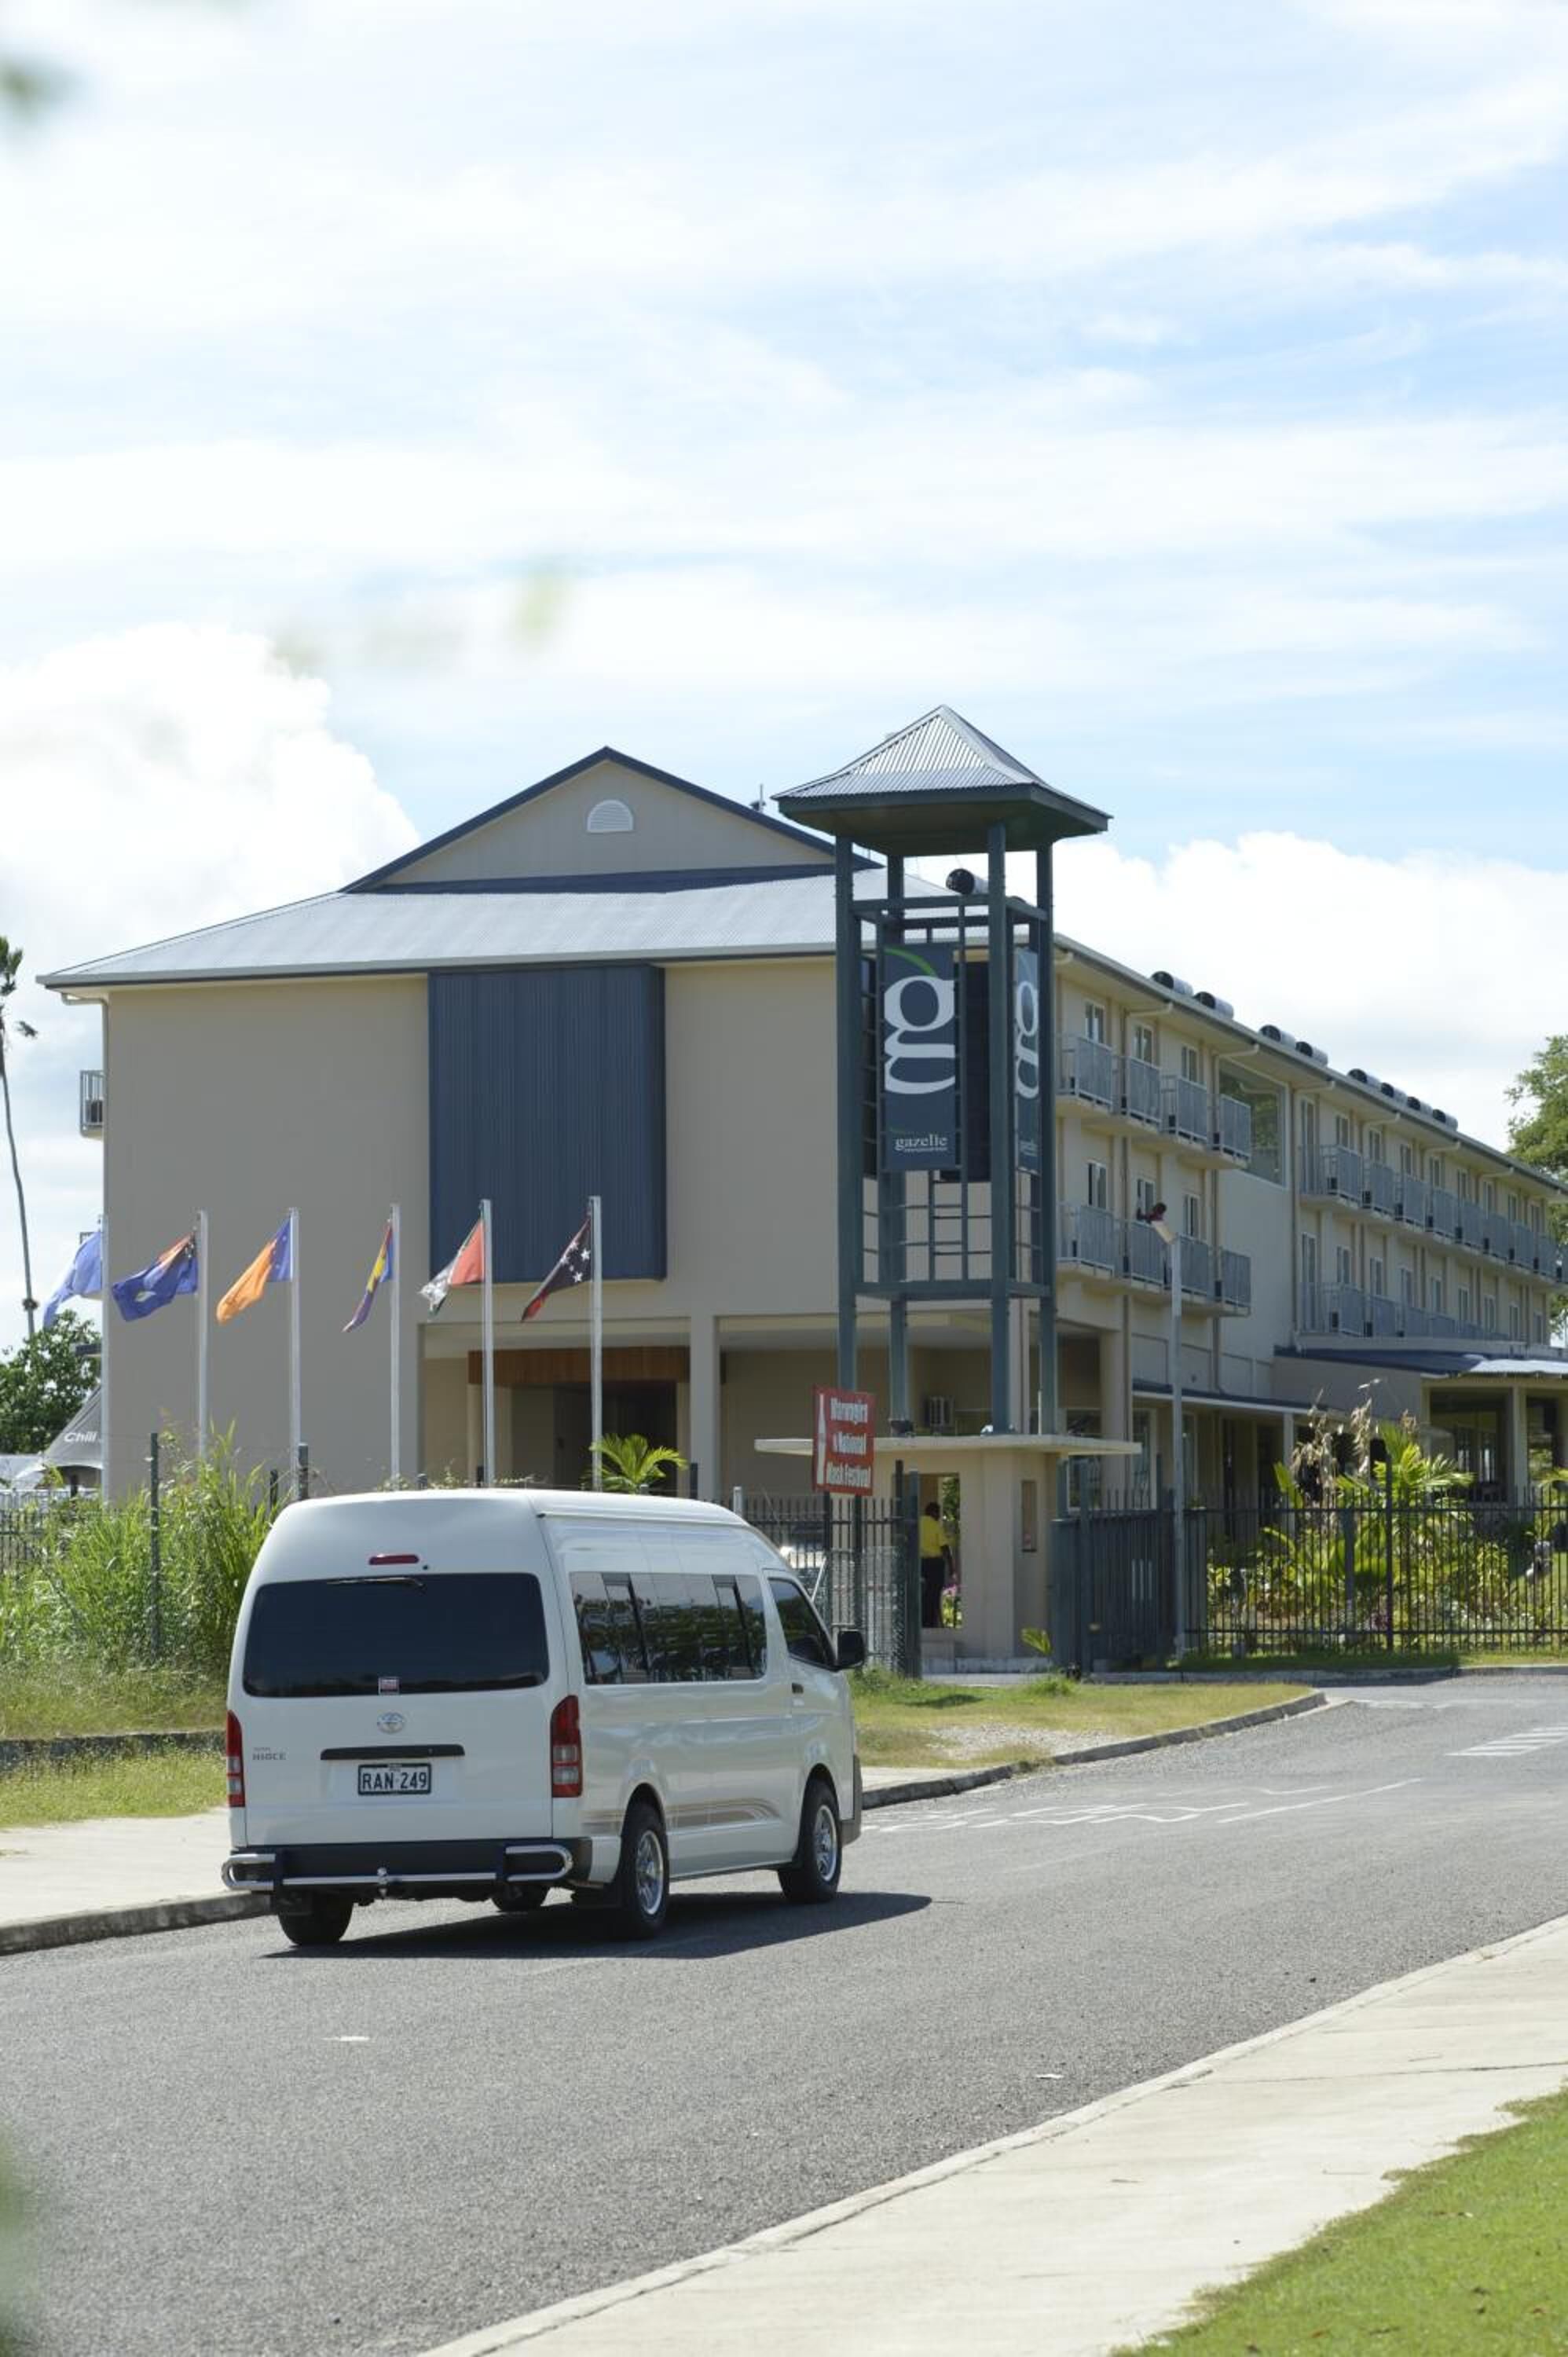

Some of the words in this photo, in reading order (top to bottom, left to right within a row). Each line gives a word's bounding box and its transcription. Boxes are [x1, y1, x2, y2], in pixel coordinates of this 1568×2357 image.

[884, 975, 955, 1094] g
[895, 1134, 948, 1151] gazelle
[64, 1431, 97, 1443] Chill
[362, 1772, 394, 1790] RAN
[400, 1772, 427, 1789] 249
